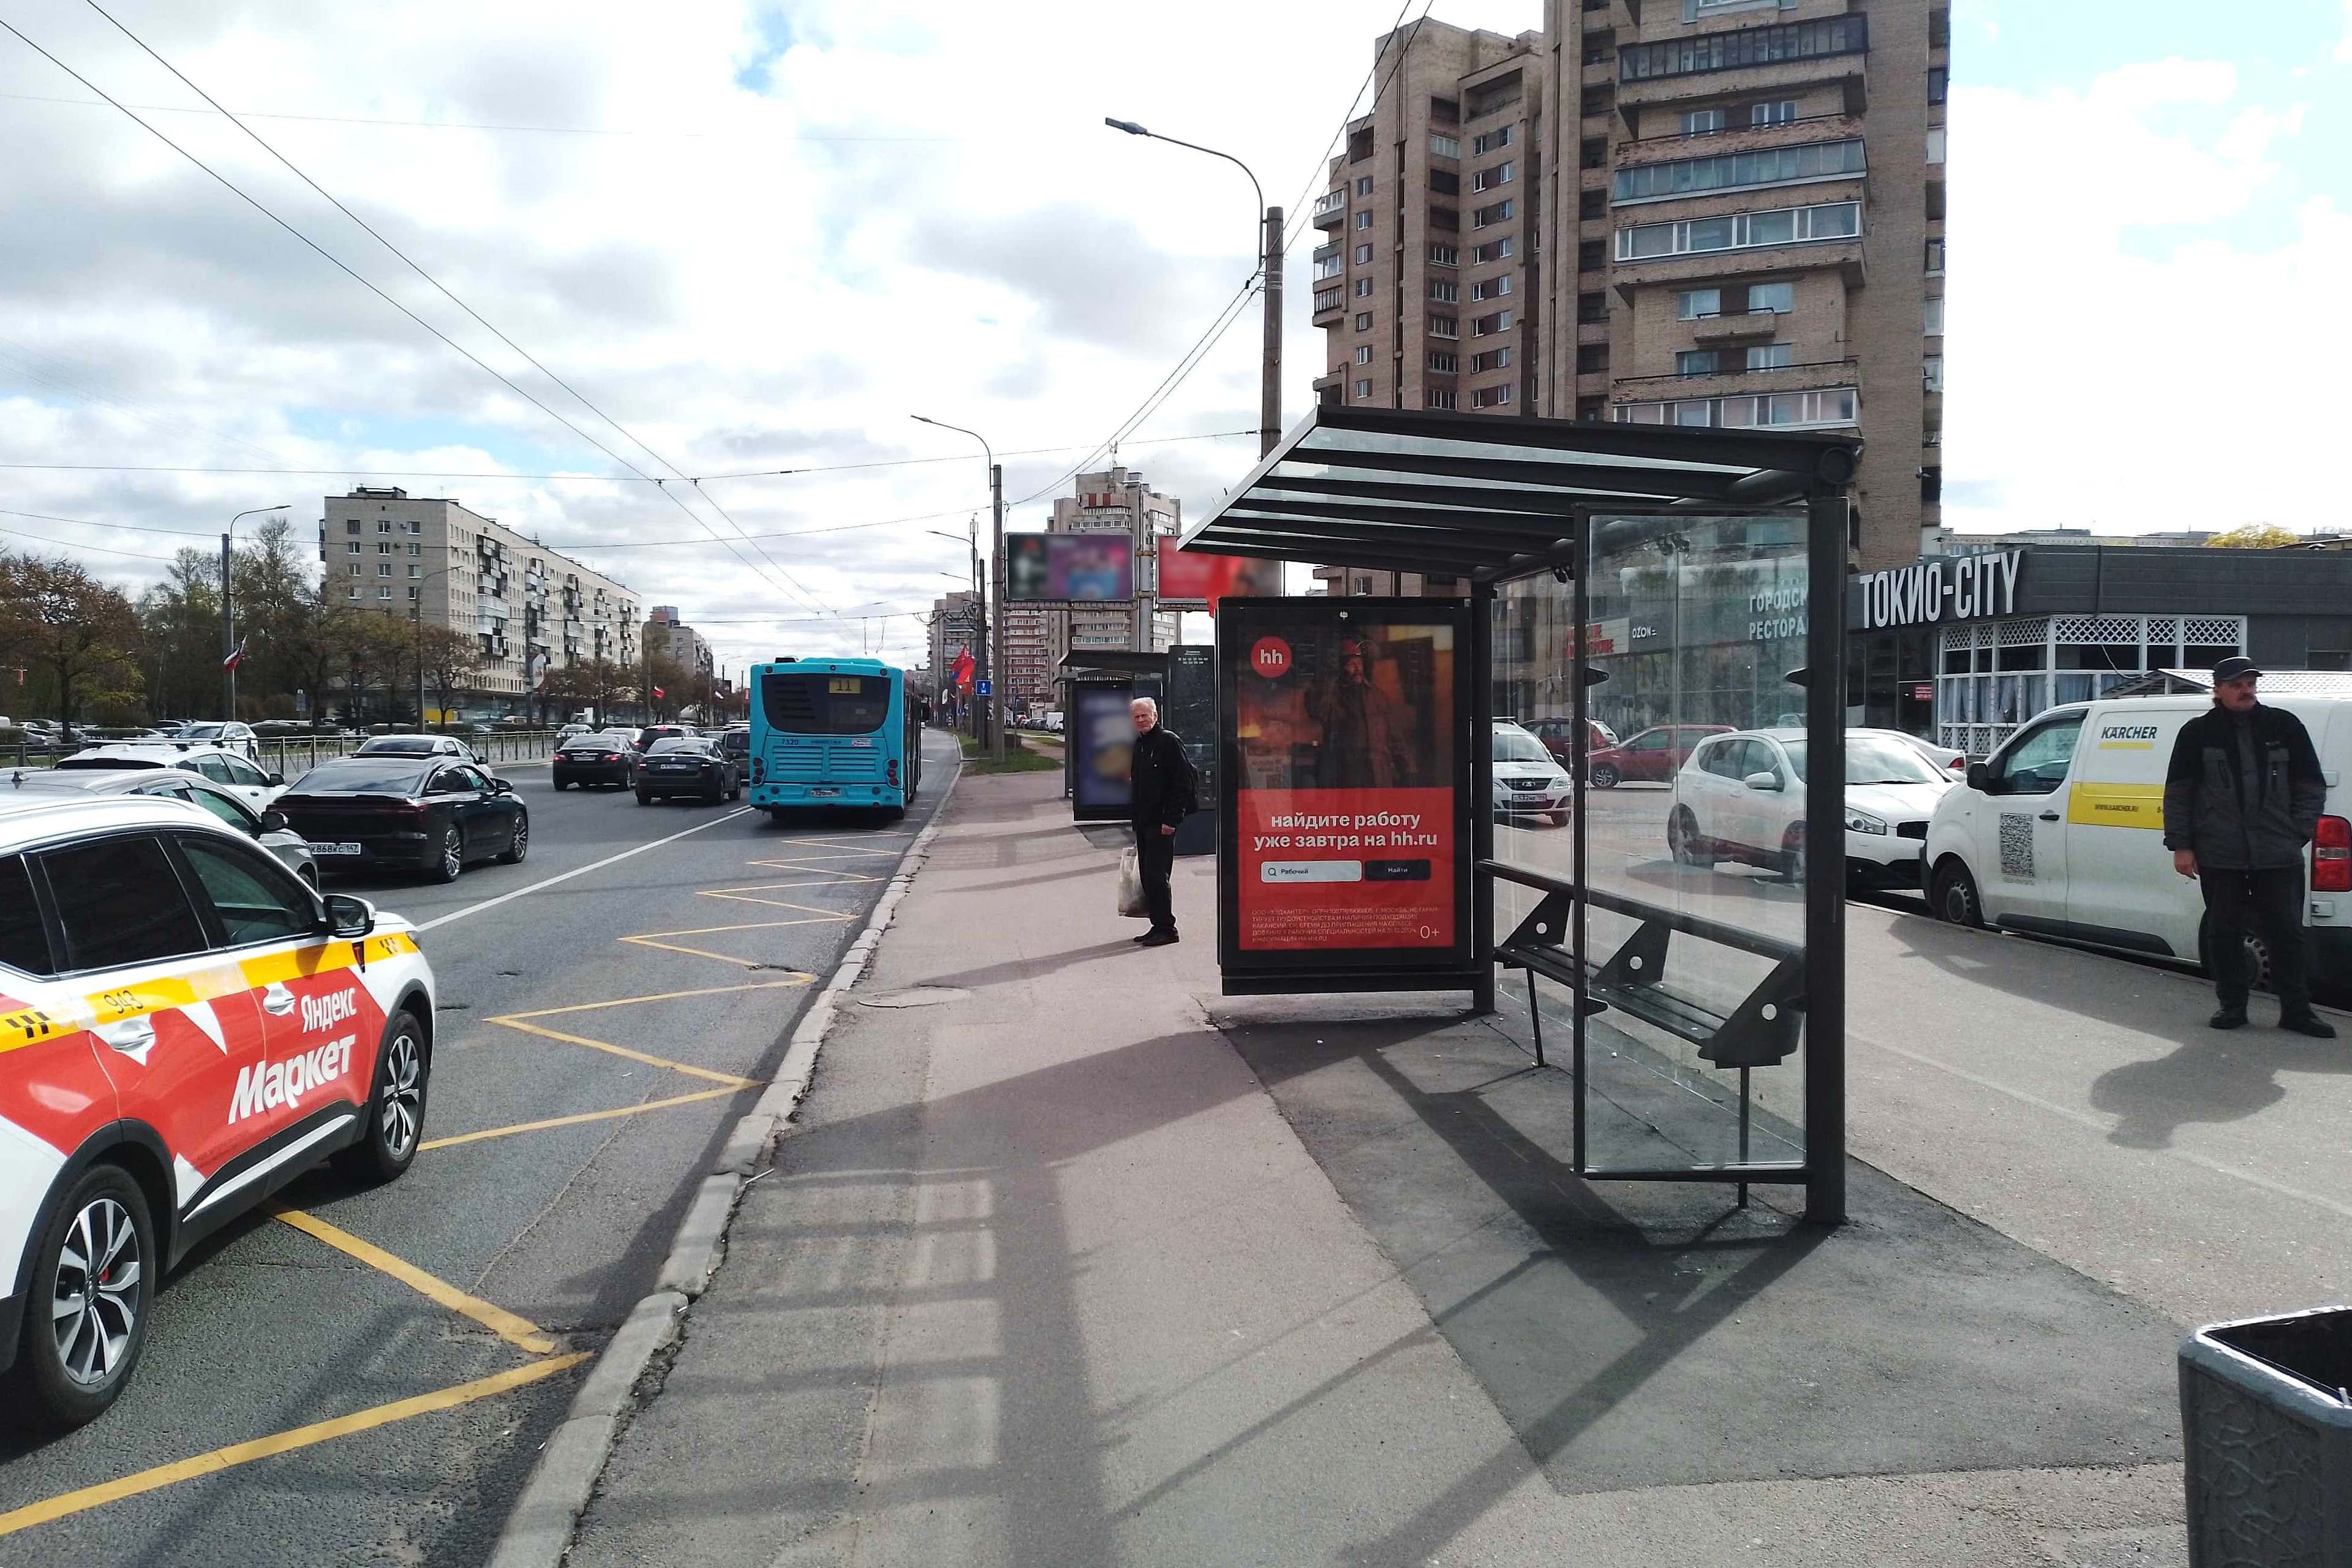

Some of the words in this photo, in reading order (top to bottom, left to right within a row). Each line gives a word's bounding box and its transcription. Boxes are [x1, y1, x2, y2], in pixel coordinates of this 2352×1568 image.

[1749, 588, 1808, 612] ГОРОДСК
[1860, 549, 2021, 628] ТОКИО-CITY
[1749, 616, 1809, 640] РЕСТОРА
[1261, 649, 1283, 664] hh
[1271, 812, 1350, 829] найдите
[1355, 811, 1420, 829] работу
[1254, 835, 1291, 851] уже
[1295, 835, 1360, 850] завтра
[1365, 835, 1385, 846] на
[1390, 831, 1437, 846] hh.ru
[1420, 925, 1439, 938] 0+
[104, 990, 144, 1014] 943
[301, 987, 356, 1033] Яндекс
[227, 1034, 356, 1125] Маркет
